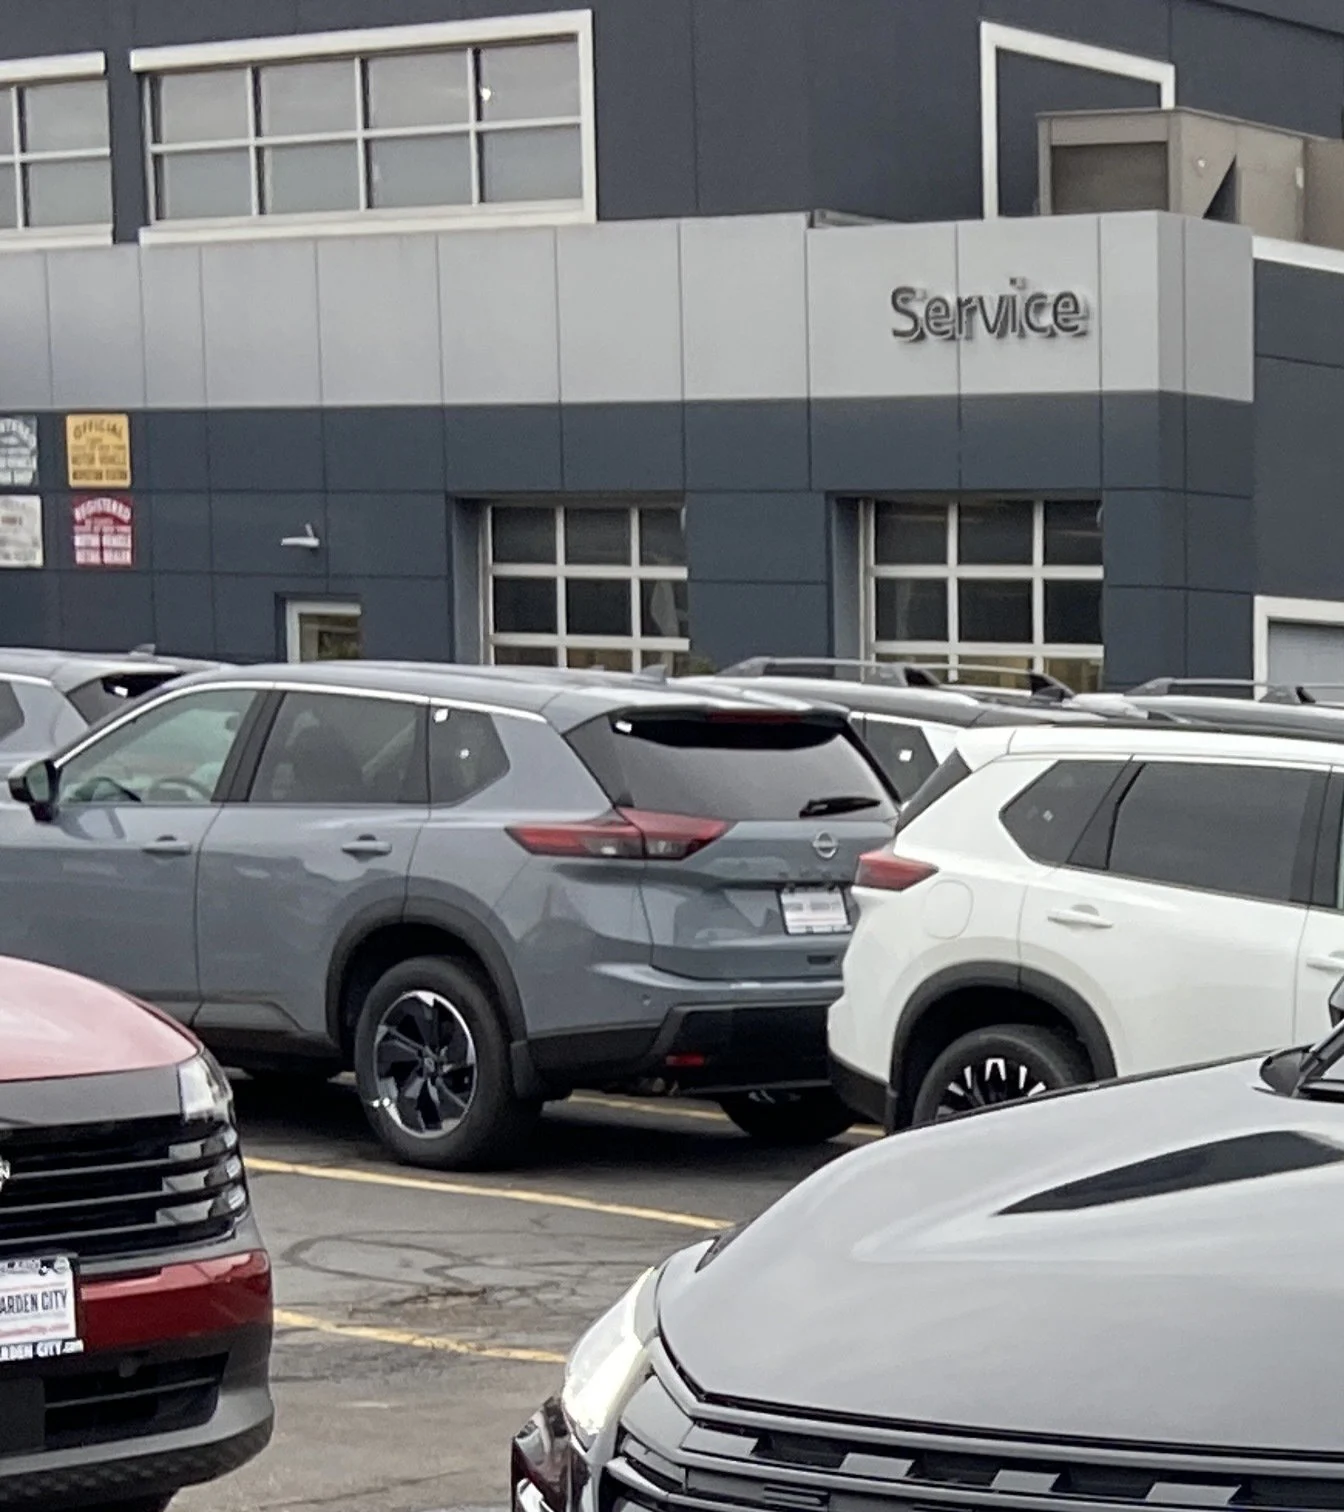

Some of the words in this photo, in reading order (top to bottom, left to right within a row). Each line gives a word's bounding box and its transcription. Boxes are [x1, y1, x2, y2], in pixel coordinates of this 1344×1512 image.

[890, 276, 1090, 344] Service
[73, 417, 124, 440] OFFICIAL
[41, 1289, 67, 1311] CITY
